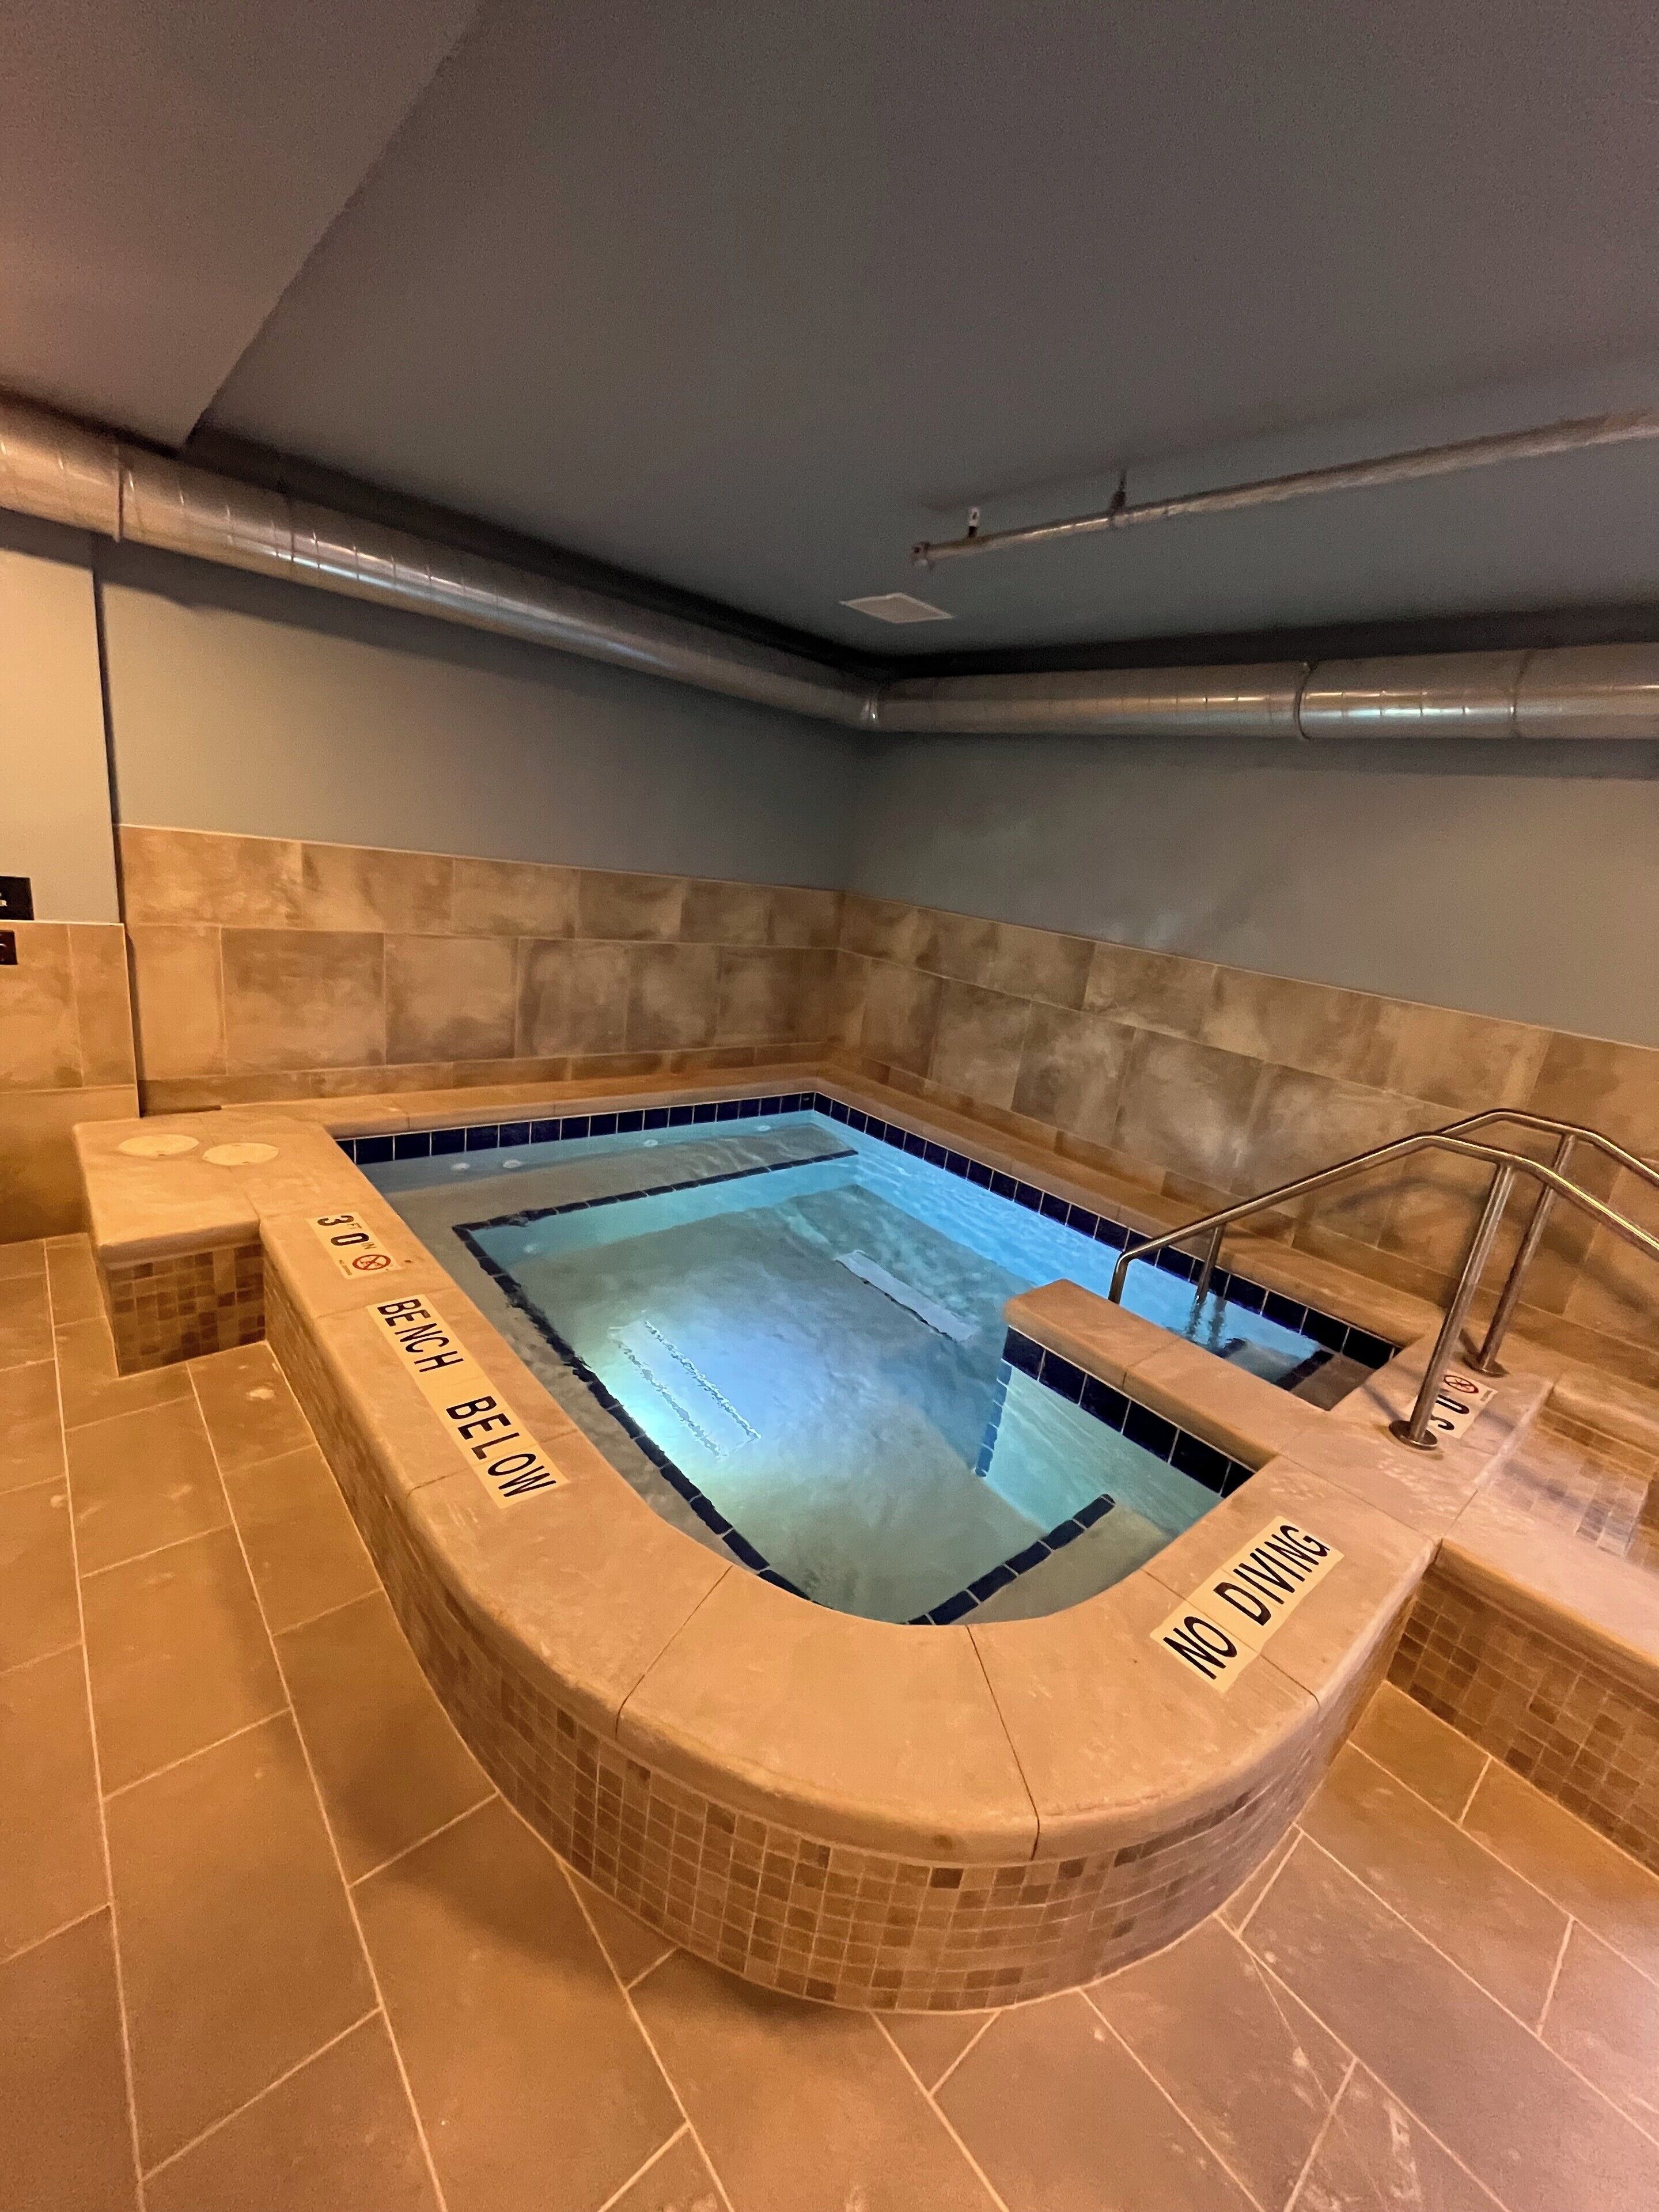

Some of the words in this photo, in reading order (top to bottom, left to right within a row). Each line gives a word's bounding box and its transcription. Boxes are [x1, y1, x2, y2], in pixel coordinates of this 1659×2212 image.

[317, 1215, 354, 1226] 3
[330, 1233, 370, 1246] 0
[377, 1298, 464, 1373] BENCH
[445, 1396, 556, 1497] BELOW
[1162, 1616, 1238, 1680] NO
[1213, 1524, 1331, 1626] DIVING
